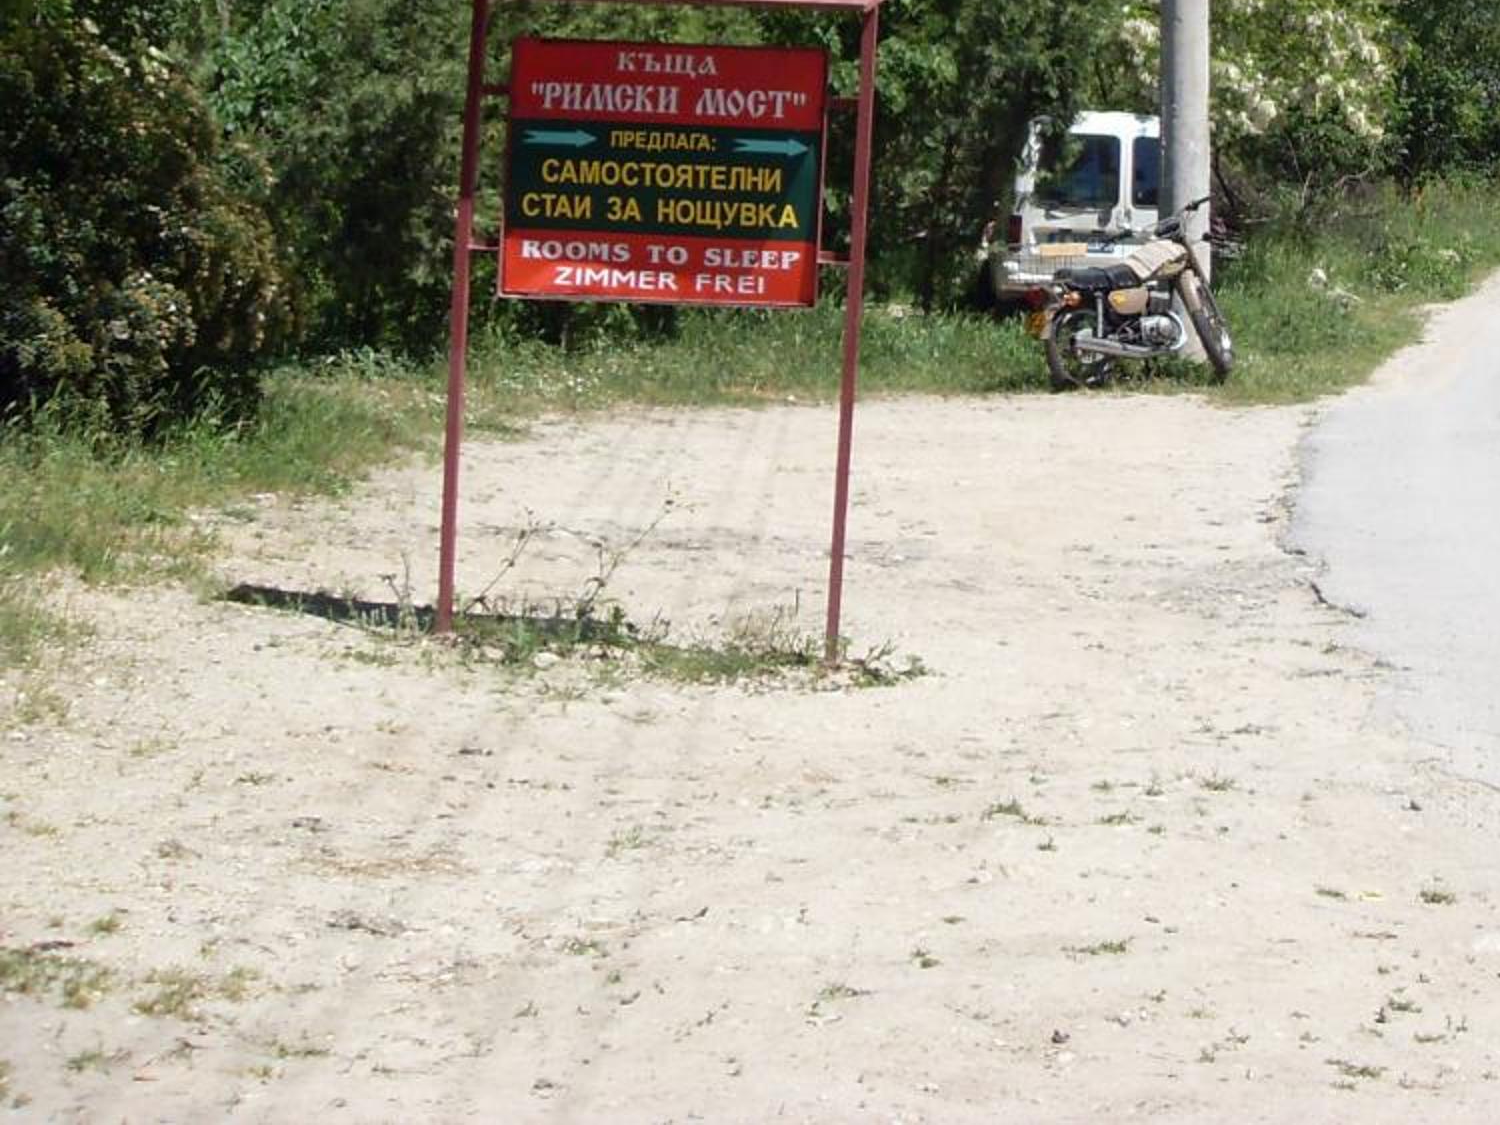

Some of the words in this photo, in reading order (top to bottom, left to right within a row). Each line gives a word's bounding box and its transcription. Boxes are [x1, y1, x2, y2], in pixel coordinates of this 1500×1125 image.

[617, 52, 718, 76] КЪЩА
[531, 81, 679, 114] "РИМСКИ
[695, 88, 807, 119] МОСТ"
[610, 130, 717, 152] ПРЕДЛАГА:
[542, 158, 782, 192] САМОСТОЯТЕЛНИ
[521, 193, 592, 220] СТАИ
[607, 196, 641, 222] ЗА
[657, 199, 799, 229] НОЩУВКА
[521, 239, 631, 261] ROOMS
[647, 245, 689, 265] TO
[704, 248, 801, 270] SLEEP
[554, 266, 679, 290] ZIMMER
[695, 274, 764, 295] FREI
